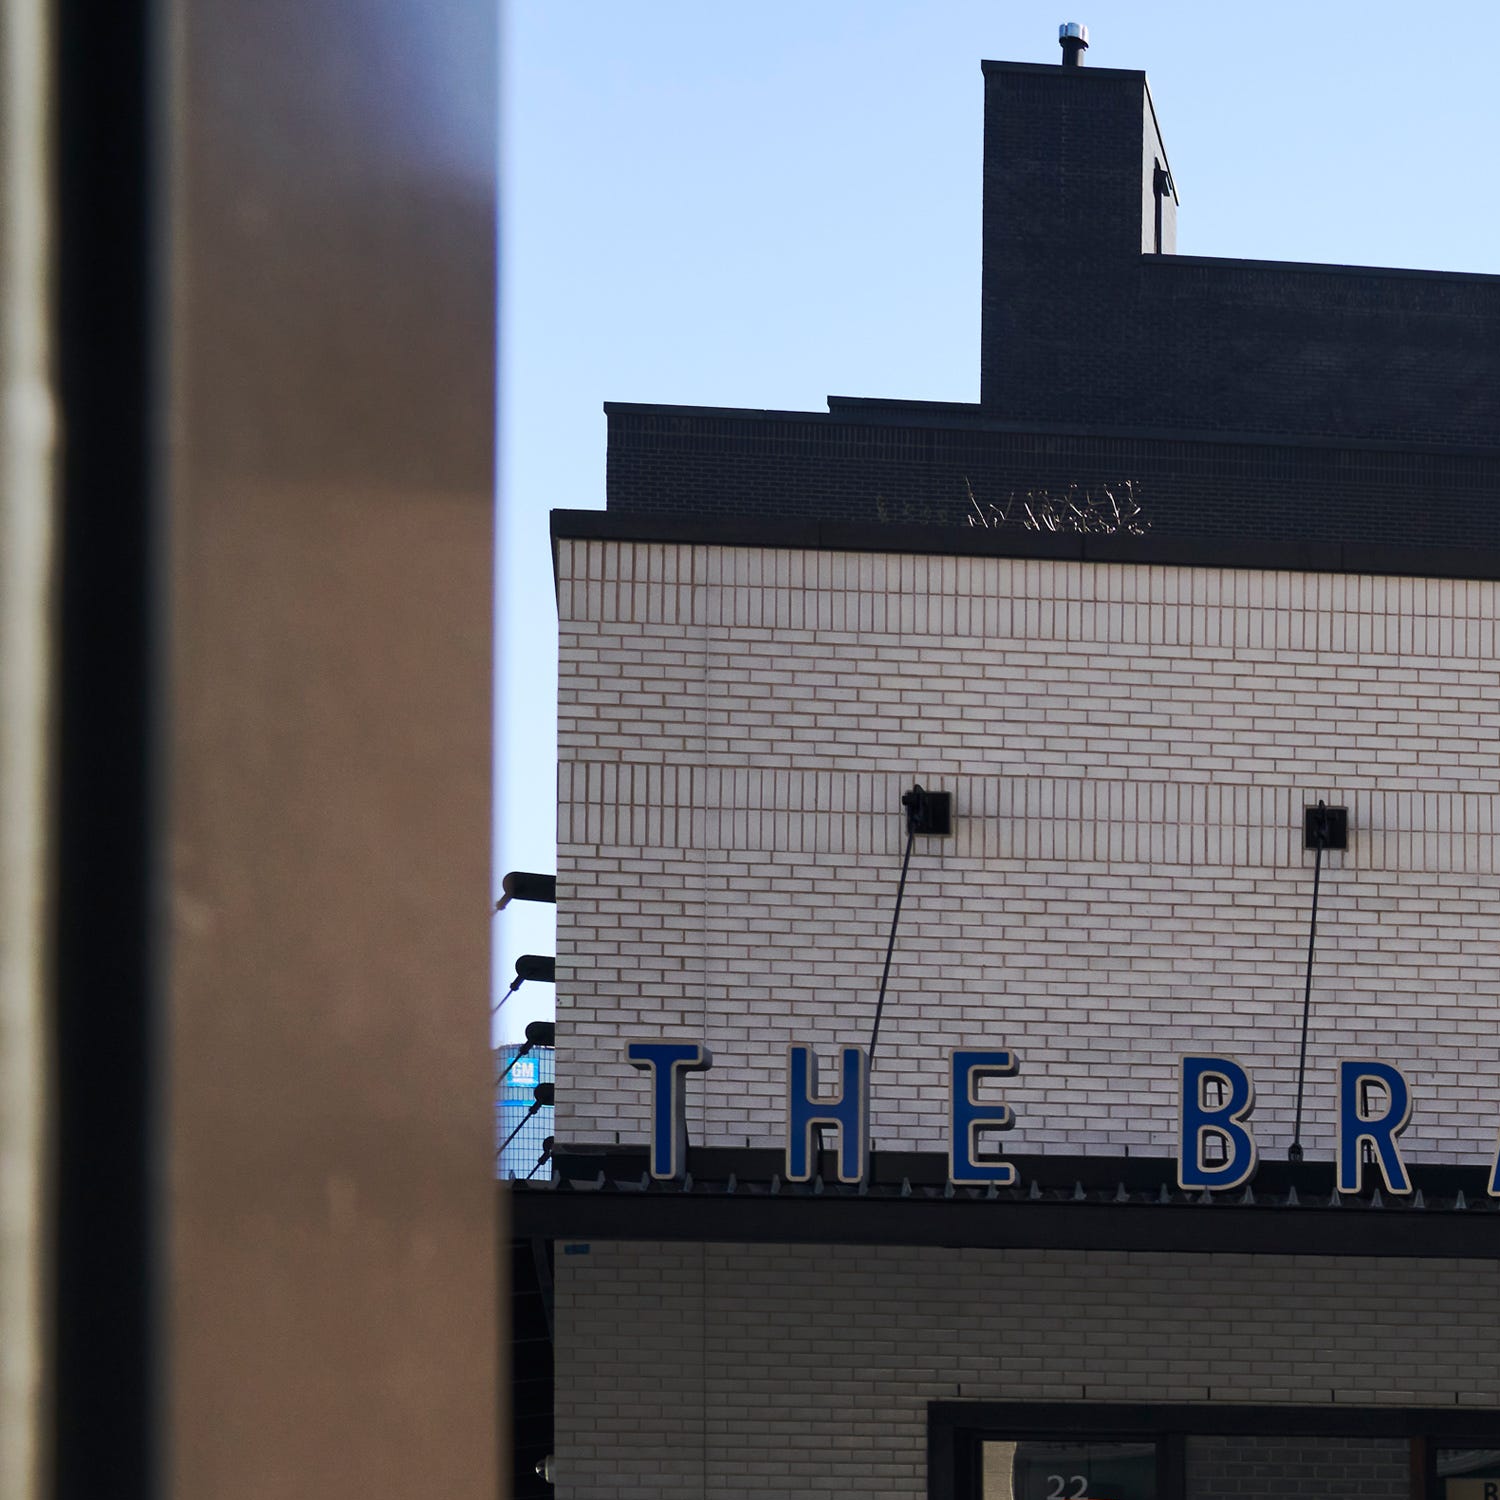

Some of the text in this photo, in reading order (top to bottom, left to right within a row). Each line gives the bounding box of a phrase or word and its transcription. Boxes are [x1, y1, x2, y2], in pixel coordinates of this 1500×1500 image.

[511, 1062, 534, 1077] GM
[624, 1038, 1022, 1187] THE
[1046, 1474, 1089, 1500] 22
